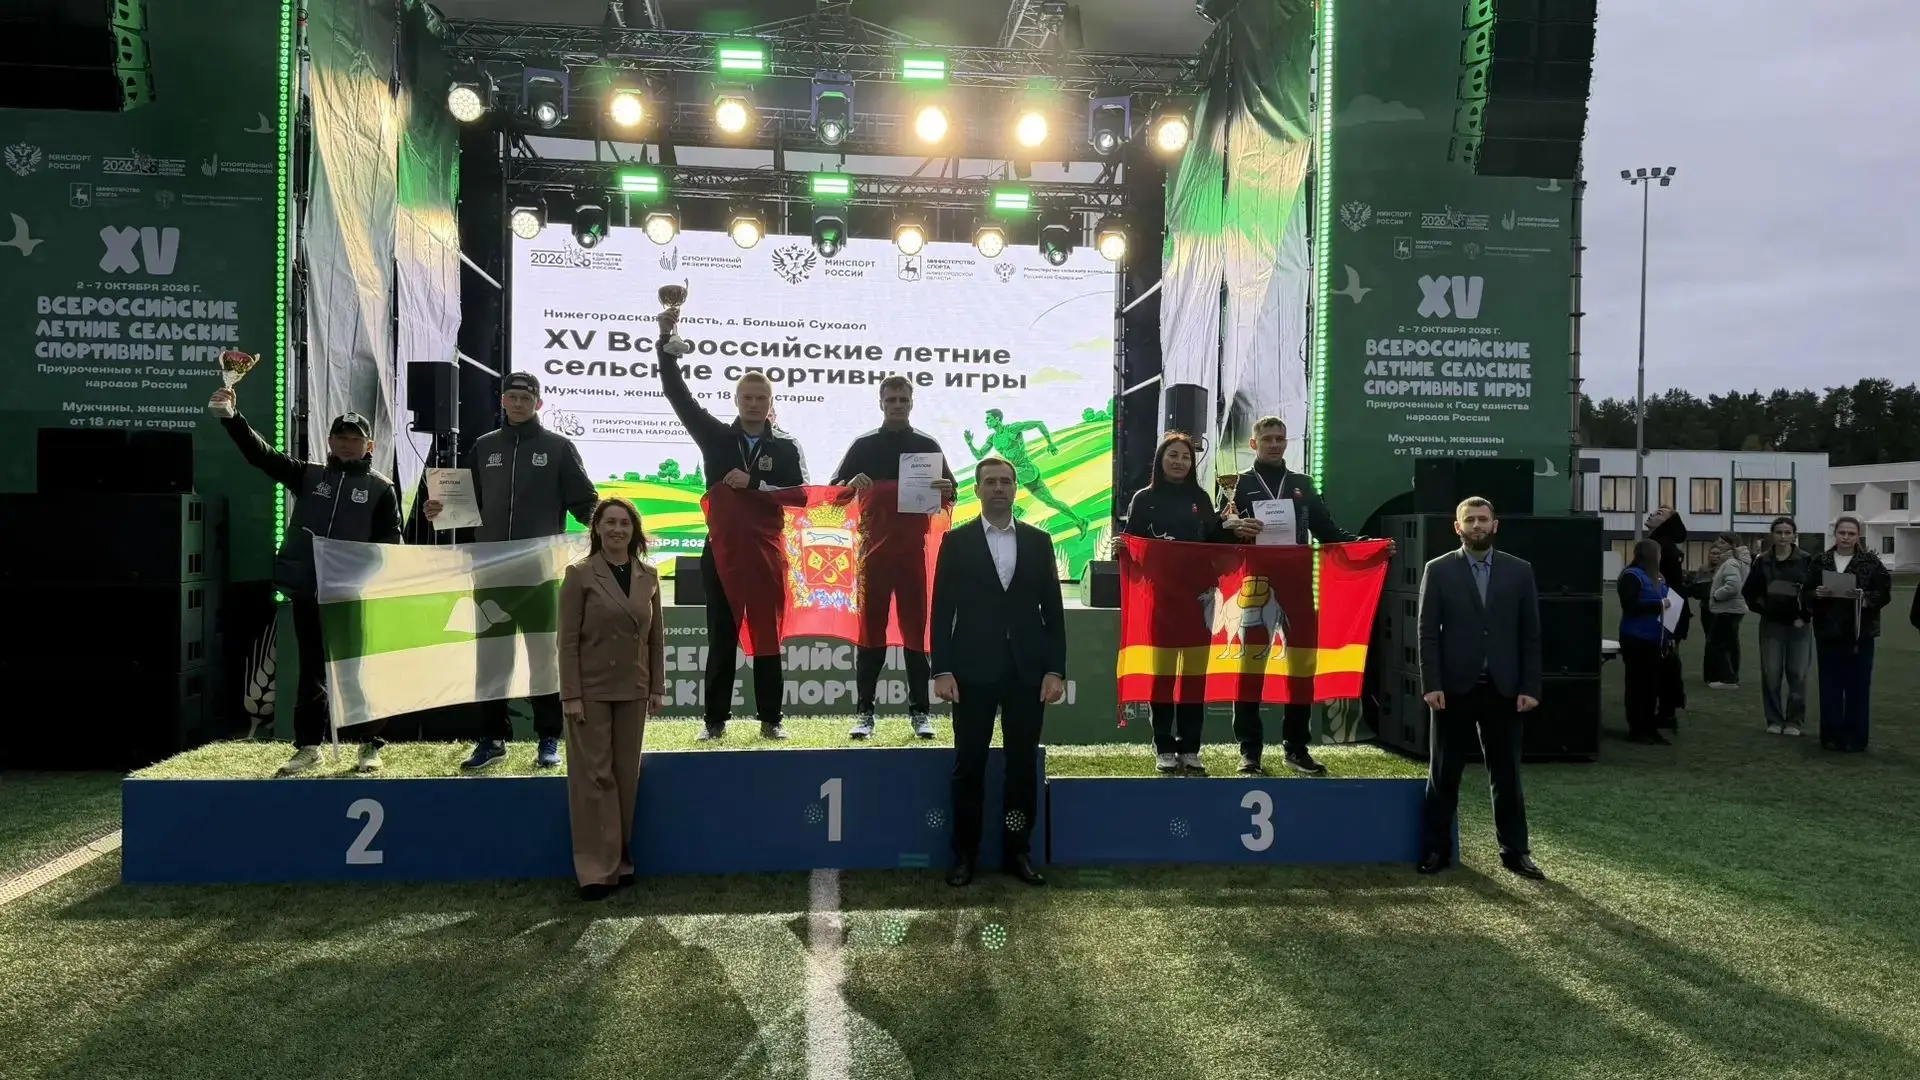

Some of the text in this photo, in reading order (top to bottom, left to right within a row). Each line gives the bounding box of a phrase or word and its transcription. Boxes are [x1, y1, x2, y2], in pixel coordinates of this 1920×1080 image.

[48, 162, 81, 170] РОССИИ
[103, 159, 133, 172] 2026
[1421, 215, 1445, 226] 2026
[99, 225, 180, 275] XV
[530, 252, 564, 265] 2026
[681, 254, 742, 263] СПОРТИВНЫЙ
[824, 259, 875, 268] МИНСПОРТ
[824, 268, 863, 277] РОССИИ
[77, 281, 84, 289] 2
[95, 282, 102, 290] 7
[104, 282, 159, 292] ОКТЯБРЯ
[162, 284, 191, 292] 2026
[1417, 274, 1484, 319] XV
[37, 296, 239, 320] ВСЕРОССИЙСКИЕ
[543, 309, 867, 331] Нижегородская ласть, д. Большой Суходол
[35, 320, 239, 342] ЛЕТНИЕ СЕЛЬСКИЕ
[1421, 326, 1466, 334] ОКТЯБРЯ
[1468, 327, 1492, 335] 2026
[35, 342, 239, 362] СПОРТИВНЫЕ ИГР
[543, 328, 1011, 365] XV Всроссийские летние
[1365, 338, 1530, 359] ВСЕРОССИЙСКИЕ
[37, 363, 132, 376] Приуроченные
[145, 366, 175, 378] Году
[178, 367, 224, 377] единст
[1364, 360, 1532, 379] ЛЕТНИЕ СЕЛЬСКИЕ
[85, 379, 188, 390] народов России
[944, 371, 1027, 392] игры
[544, 385, 620, 398] Мужчины,
[697, 391, 713, 399] от
[717, 391, 731, 399] 18
[774, 394, 825, 403] старше
[1364, 380, 1531, 397] СПОРТИВНЫЕ ИГРЫ
[62, 401, 204, 415] Мужчины, женщины
[1366, 400, 1444, 410] Приуроченные
[1455, 401, 1480, 411] Году
[1482, 403, 1529, 411] единства
[70, 417, 197, 430] от 18 лет и старше
[592, 418, 658, 426] ПРИУРОЧЕНЫ
[1406, 413, 1490, 423] народов России
[592, 427, 643, 435] ЕДИНСТВА
[1388, 434, 1447, 444] Мужчины,
[1410, 447, 1422, 456] 18
[1425, 448, 1445, 456] лет
[1457, 449, 1498, 458] старше
[682, 538, 705, 548] 202
[781, 679, 952, 706] ПОРТИВ
[820, 777, 842, 842] 1
[1240, 789, 1275, 852] 3
[346, 798, 385, 865] 2
